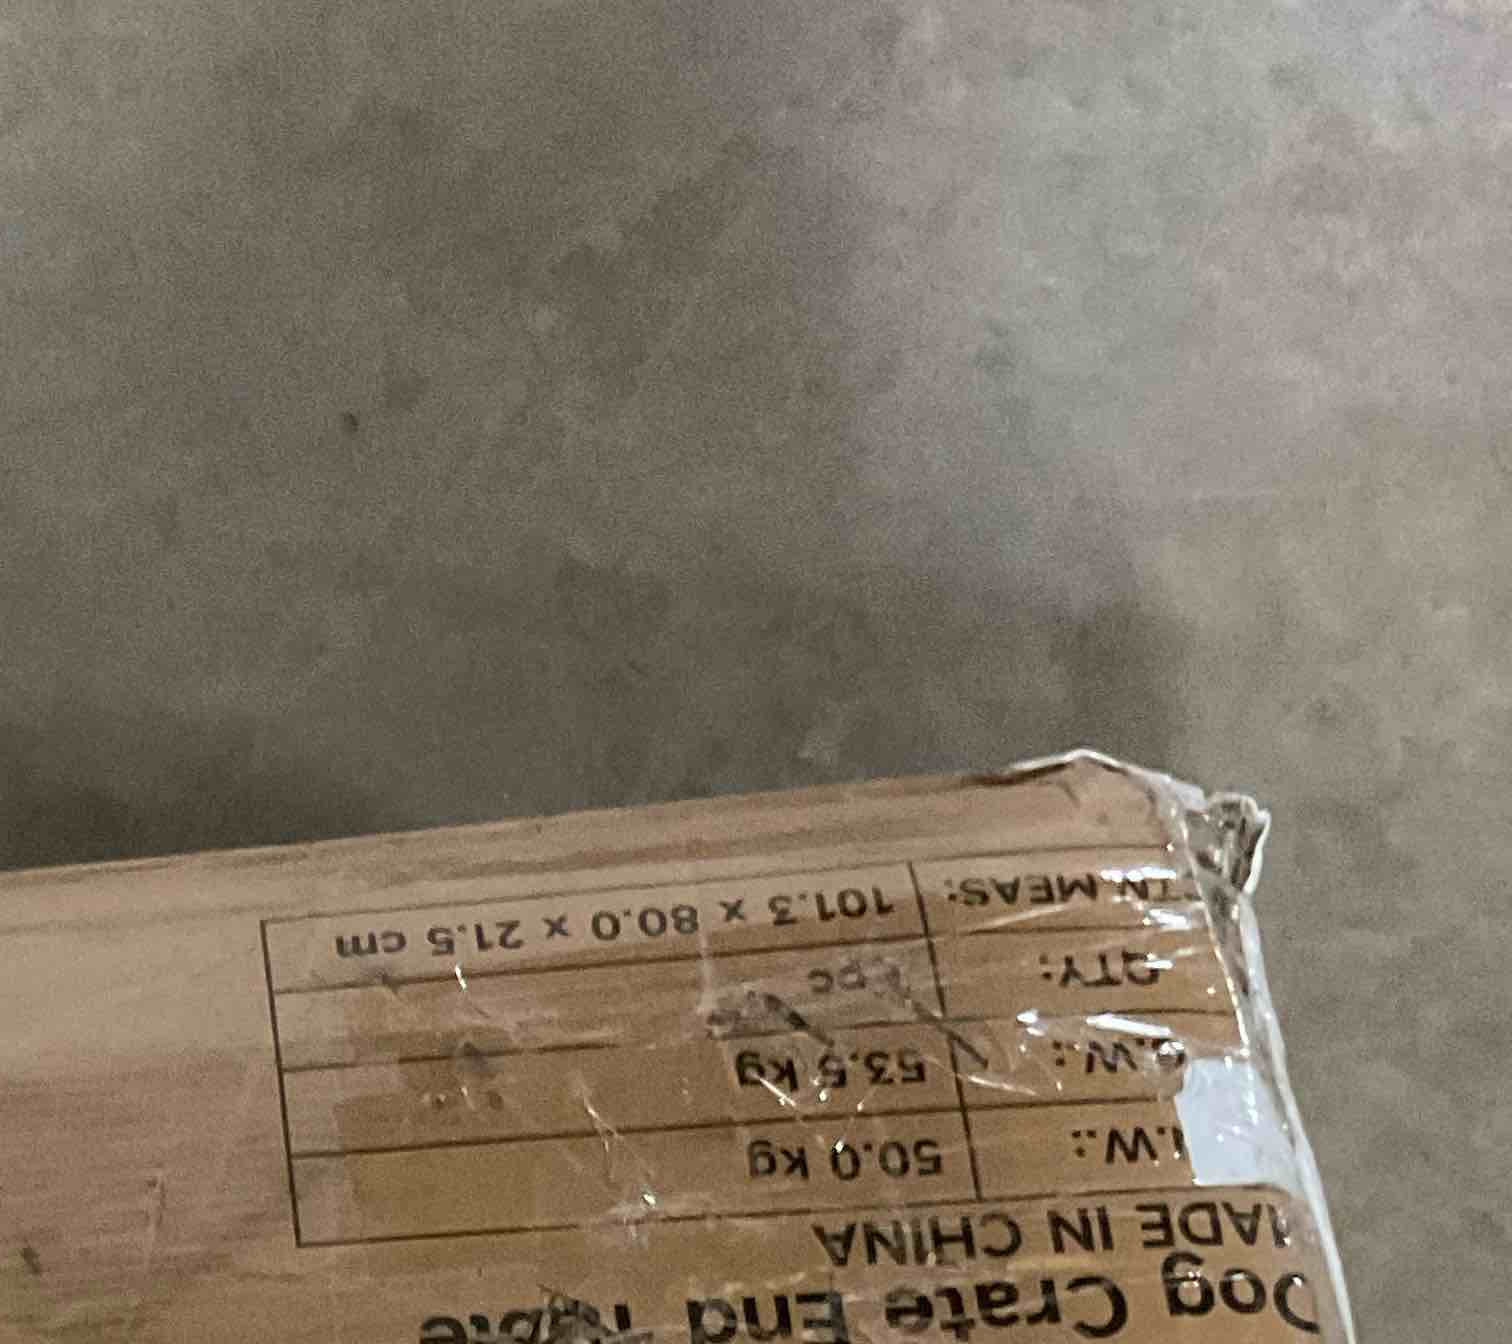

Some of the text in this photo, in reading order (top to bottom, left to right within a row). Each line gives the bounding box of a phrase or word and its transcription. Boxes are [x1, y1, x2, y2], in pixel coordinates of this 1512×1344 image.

[943, 874, 1098, 908] MEAS:
[334, 887, 896, 959] 101.3 x 80.0 x 21.5 cm
[1039, 951, 1162, 990] QTY:
[735, 1050, 926, 1092] 53.5 kg
[747, 1140, 943, 1183] 50.0 kg
[811, 1213, 1022, 1267] CHINA
[1046, 1206, 1112, 1254] IN
[884, 1277, 1128, 1343] Crate
